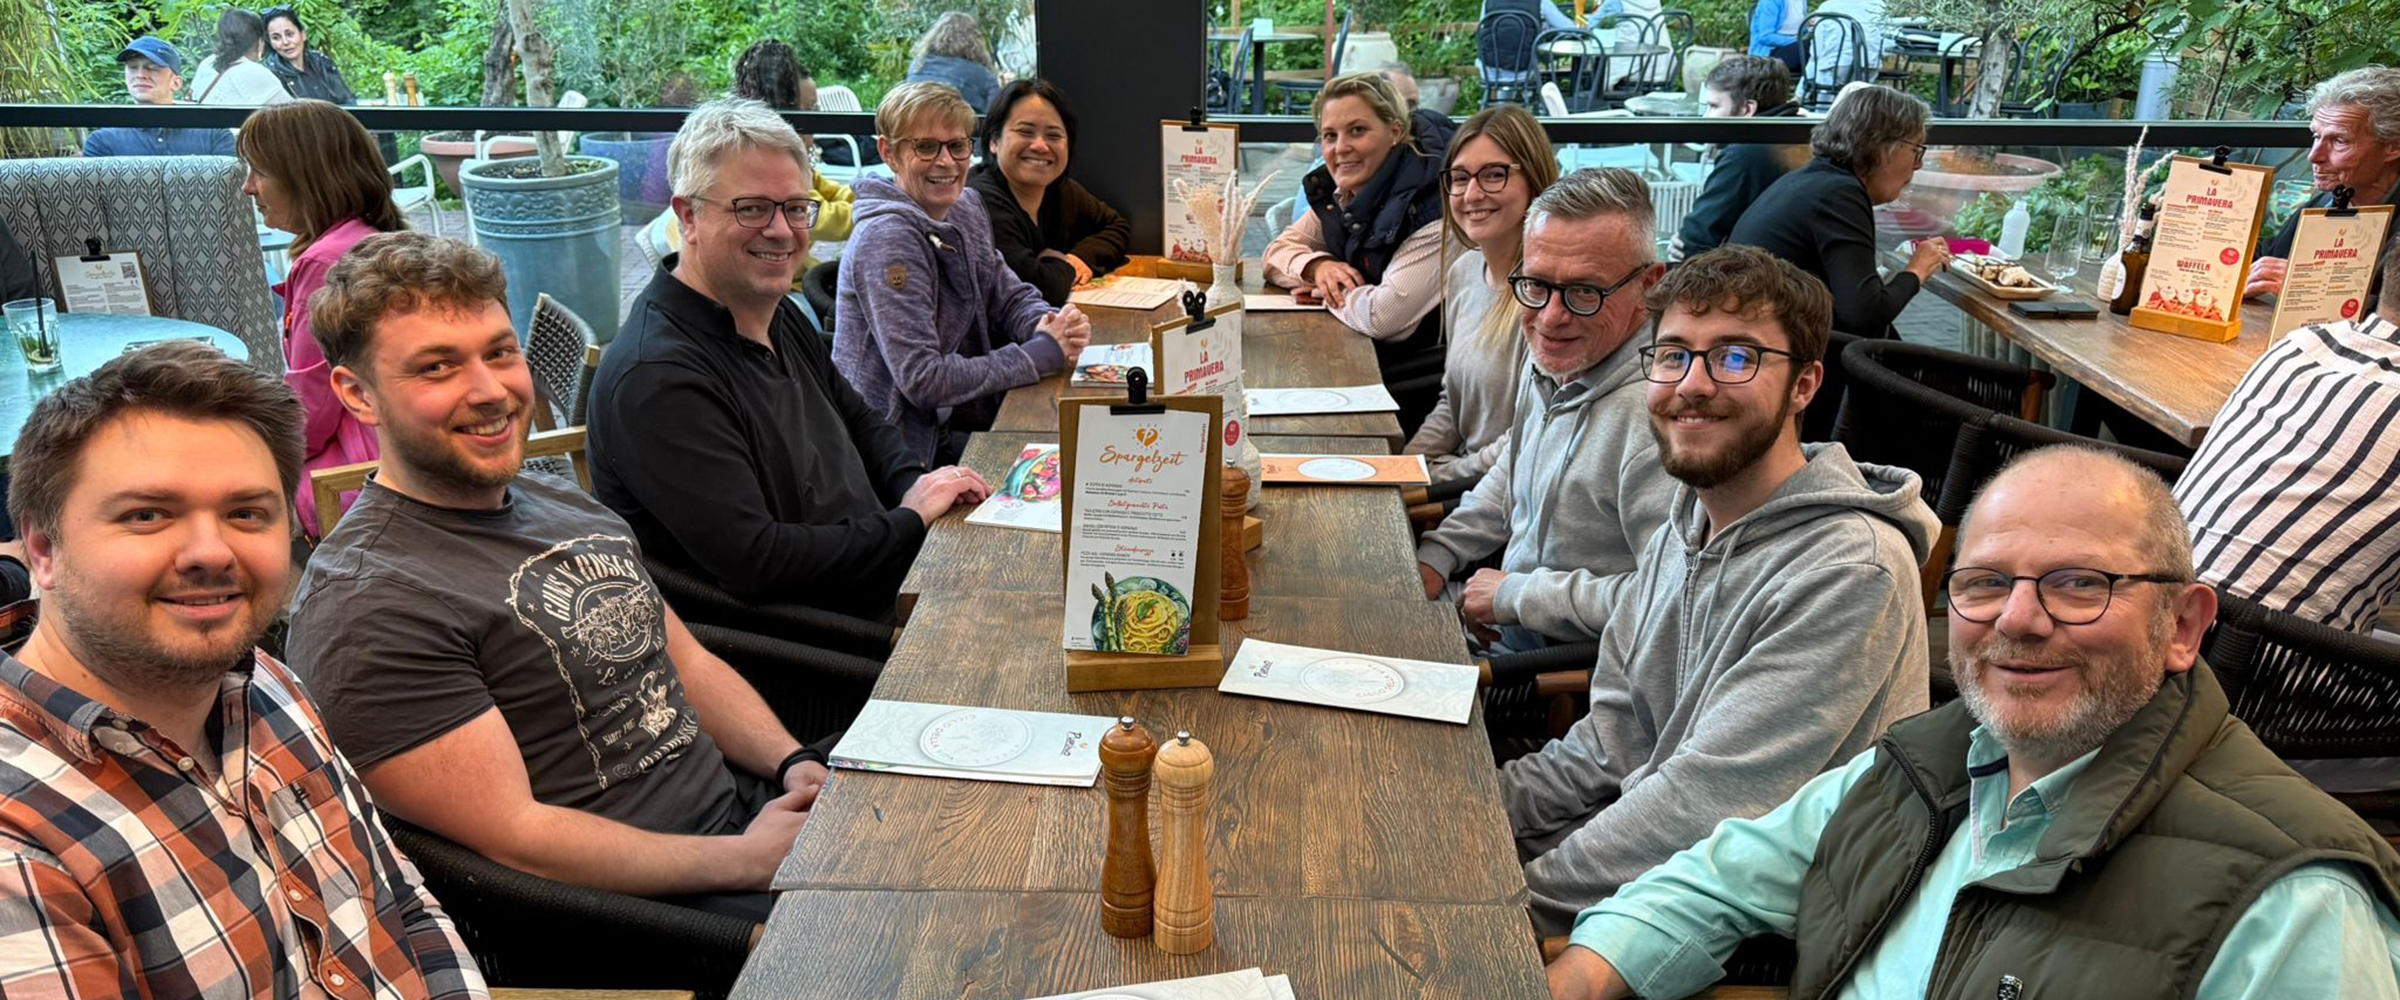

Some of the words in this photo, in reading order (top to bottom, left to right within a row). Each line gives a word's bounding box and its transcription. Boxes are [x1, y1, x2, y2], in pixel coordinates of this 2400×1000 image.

[2206, 187, 2217, 196] LA
[2185, 194, 2234, 209] PRIMAVERA
[2334, 238, 2344, 248] LA
[2314, 248, 2358, 260] PRIMAVERA
[1199, 351, 1209, 364] LA
[1184, 360, 1225, 384] PRIMAVERA
[1099, 445, 1189, 473] Spargelzeit
[542, 573, 575, 622] GUNS
[575, 553, 640, 583] ROSES
